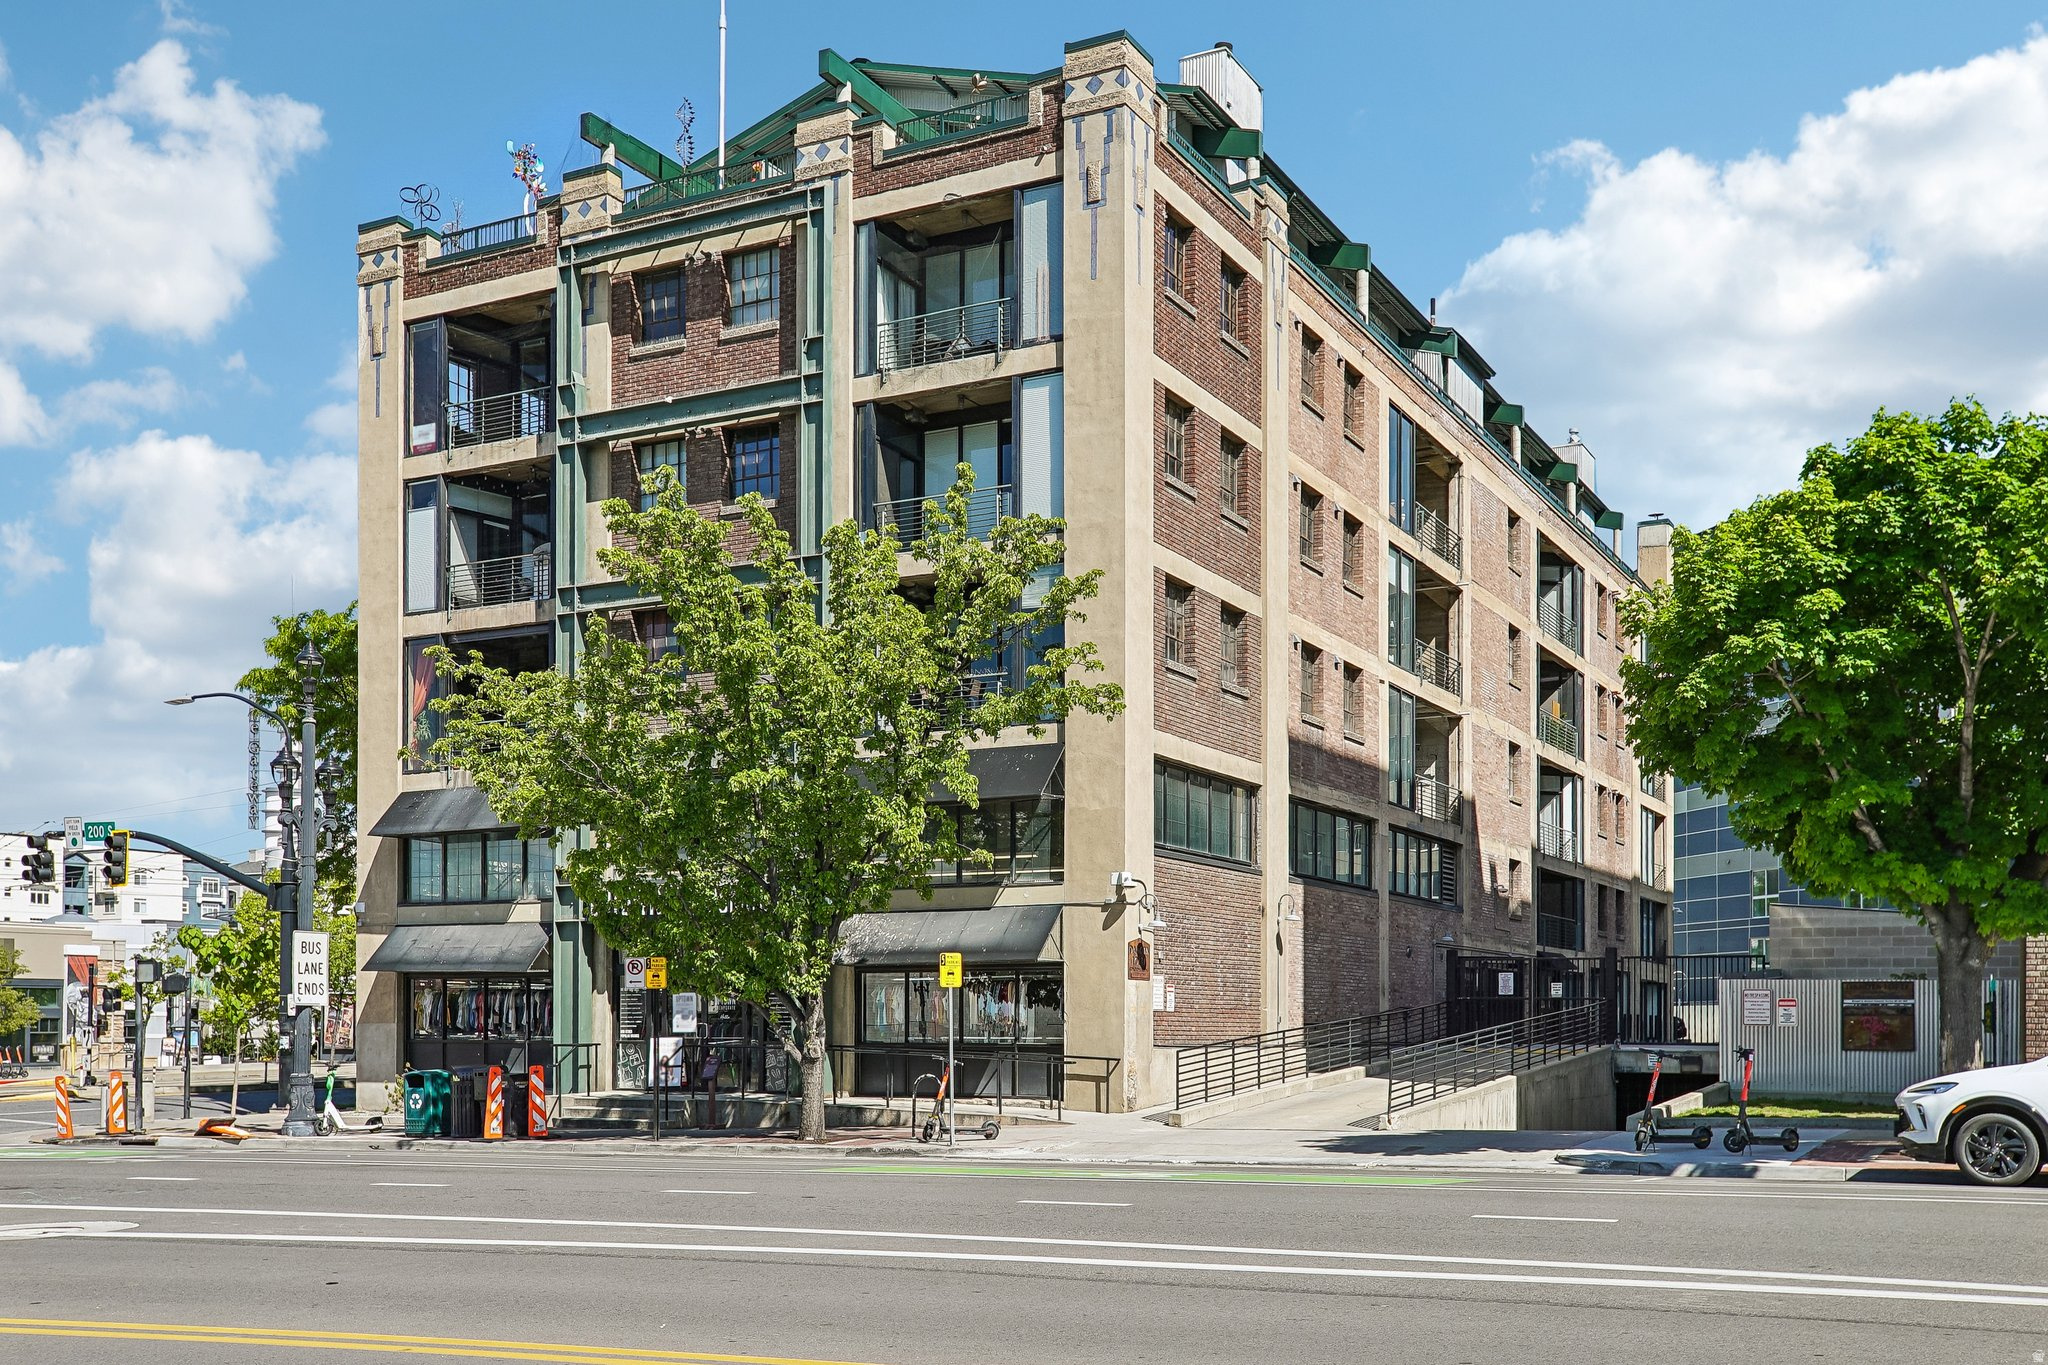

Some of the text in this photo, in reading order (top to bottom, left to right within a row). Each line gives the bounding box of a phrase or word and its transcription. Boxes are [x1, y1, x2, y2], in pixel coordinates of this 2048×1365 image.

[87, 825, 113, 838] 200 S
[301, 940, 322, 955] BUS
[297, 961, 324, 975] LANE
[297, 982, 325, 996] ENDS
